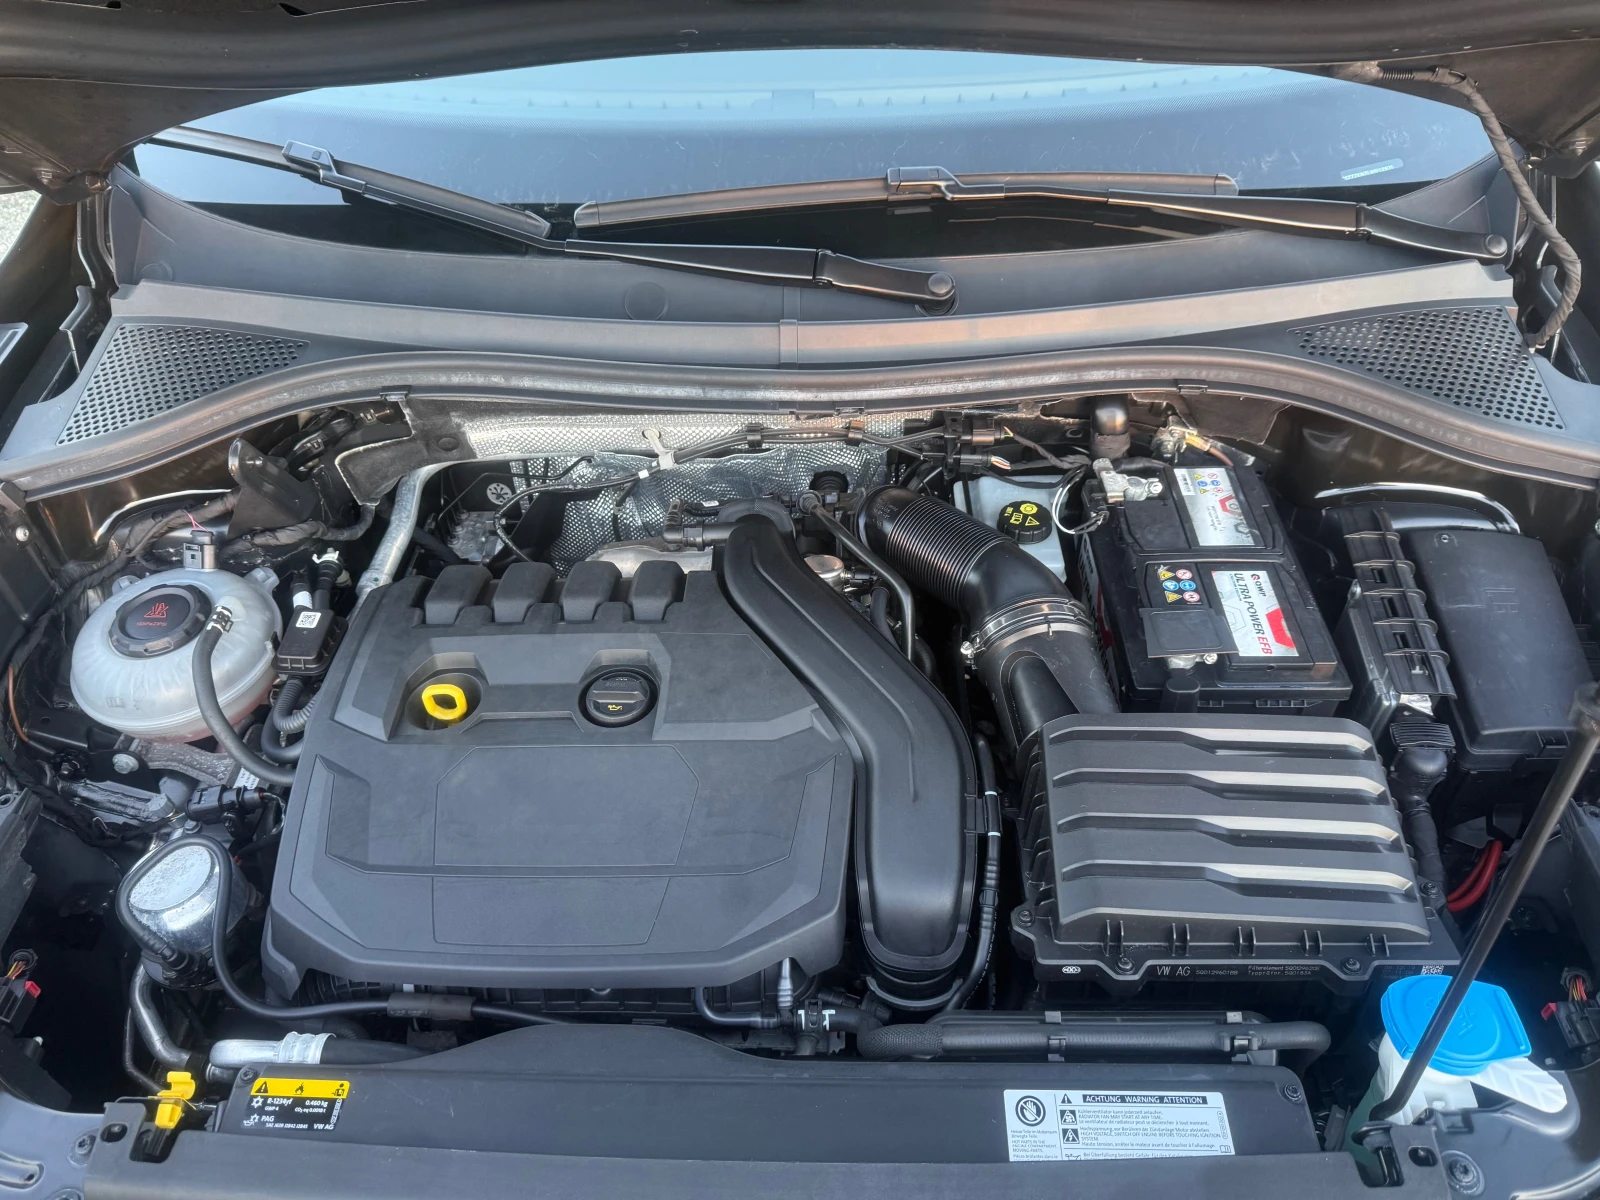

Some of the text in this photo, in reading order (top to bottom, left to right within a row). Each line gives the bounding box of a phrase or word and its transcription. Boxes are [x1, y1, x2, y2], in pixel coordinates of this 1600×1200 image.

[1234, 573, 1273, 655] ULTRA POWER EFB
[1156, 966, 1191, 976] VW AG
[266, 1097, 293, 1106] R-1234yf
[1085, 1095, 1121, 1103] ACHTUNG
[1163, 1096, 1203, 1104] ATTENTION
